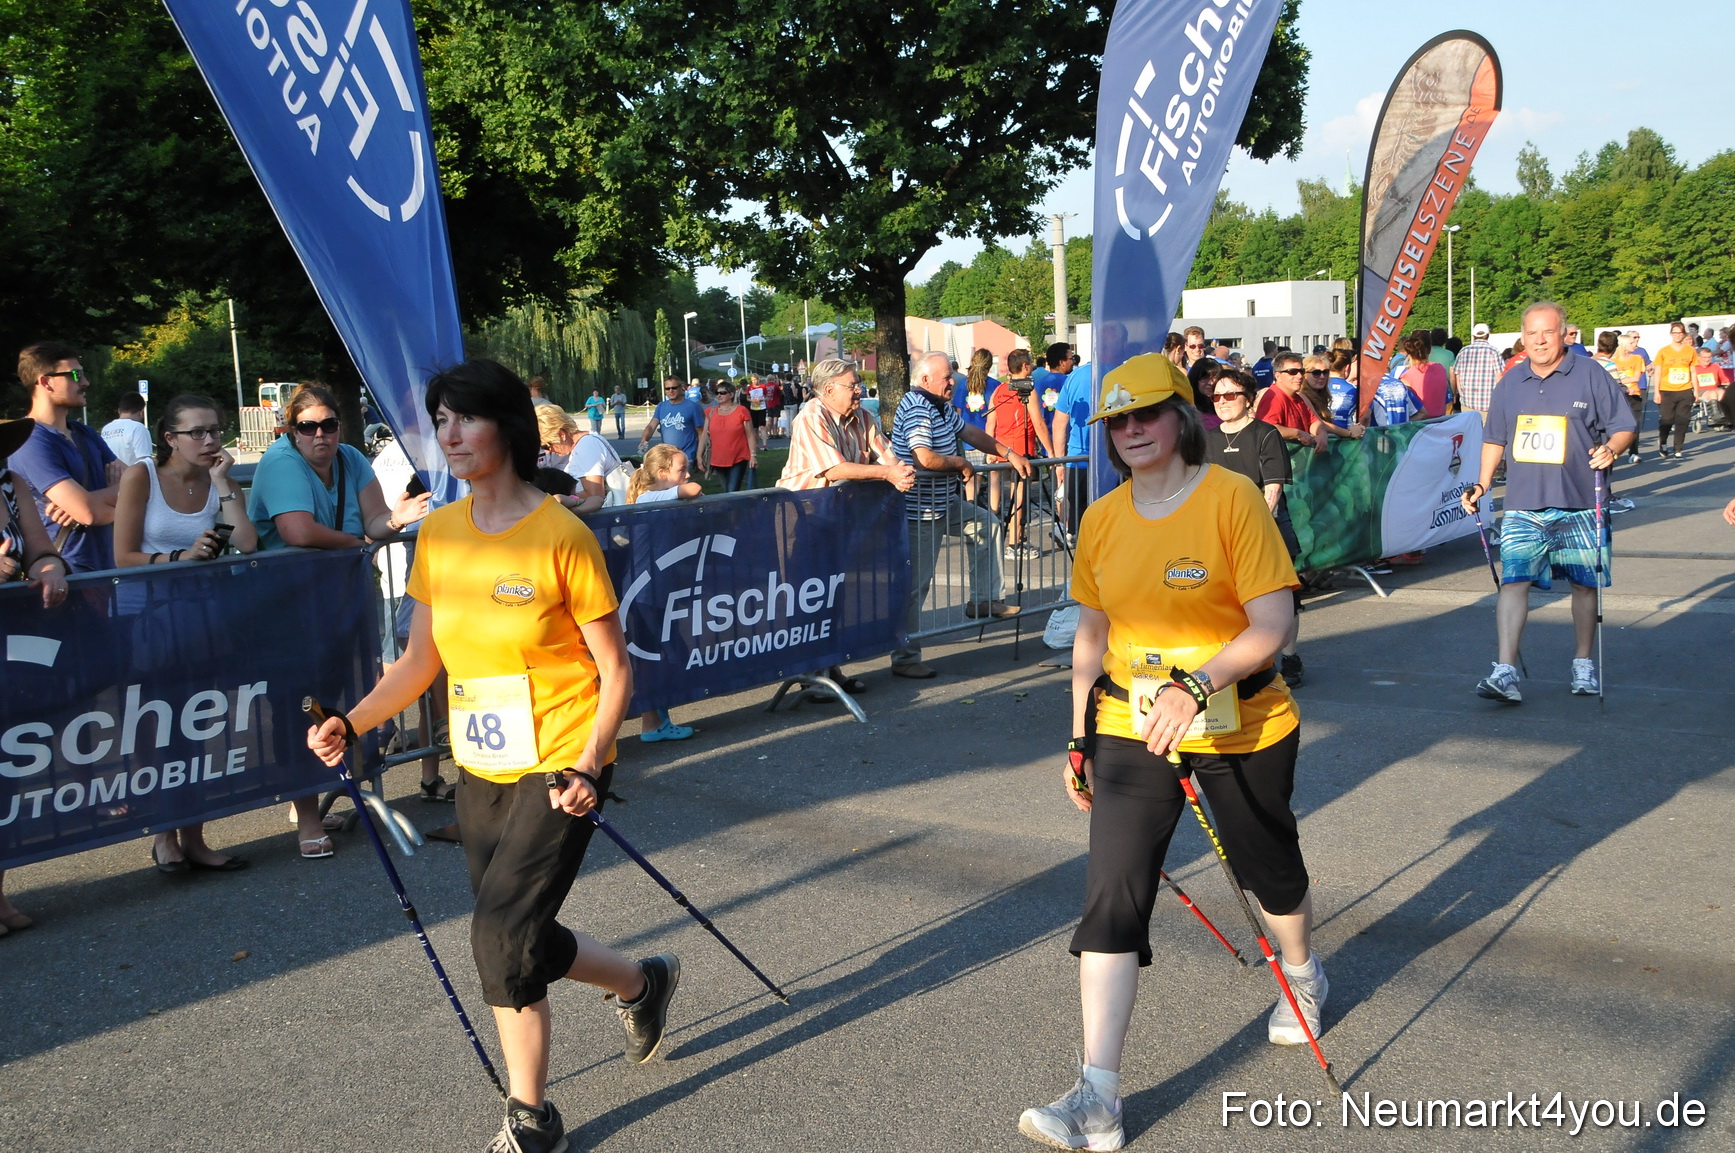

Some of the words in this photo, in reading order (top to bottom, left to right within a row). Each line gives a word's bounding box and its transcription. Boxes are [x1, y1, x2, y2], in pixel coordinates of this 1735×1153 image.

[1521, 432, 1555, 450] 700
[661, 571, 846, 643] Fischer
[685, 618, 832, 671] AUTOMOBILE
[466, 712, 506, 751] 48
